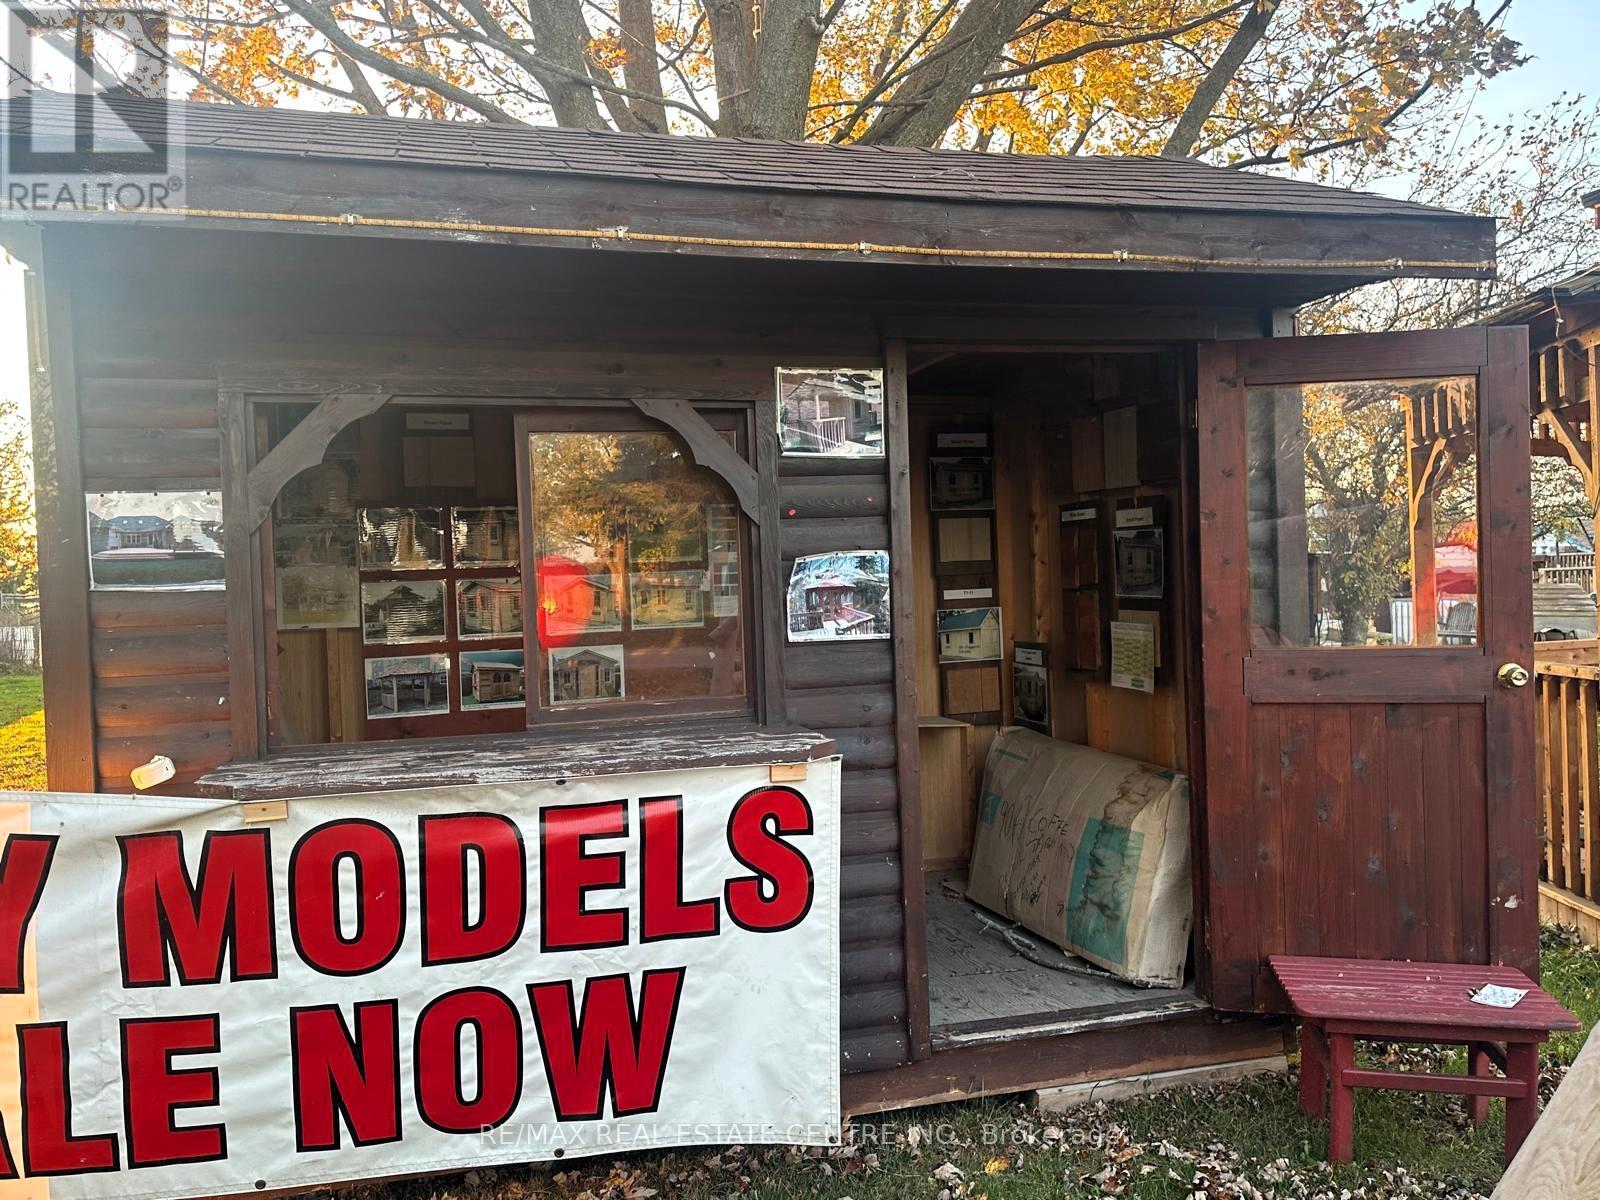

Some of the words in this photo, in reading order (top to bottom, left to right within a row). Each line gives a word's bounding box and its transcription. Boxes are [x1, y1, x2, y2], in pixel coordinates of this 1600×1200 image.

[115, 785, 815, 989] MODELS
[0, 1014, 229, 1179] LE
[289, 966, 687, 1153] NOW
